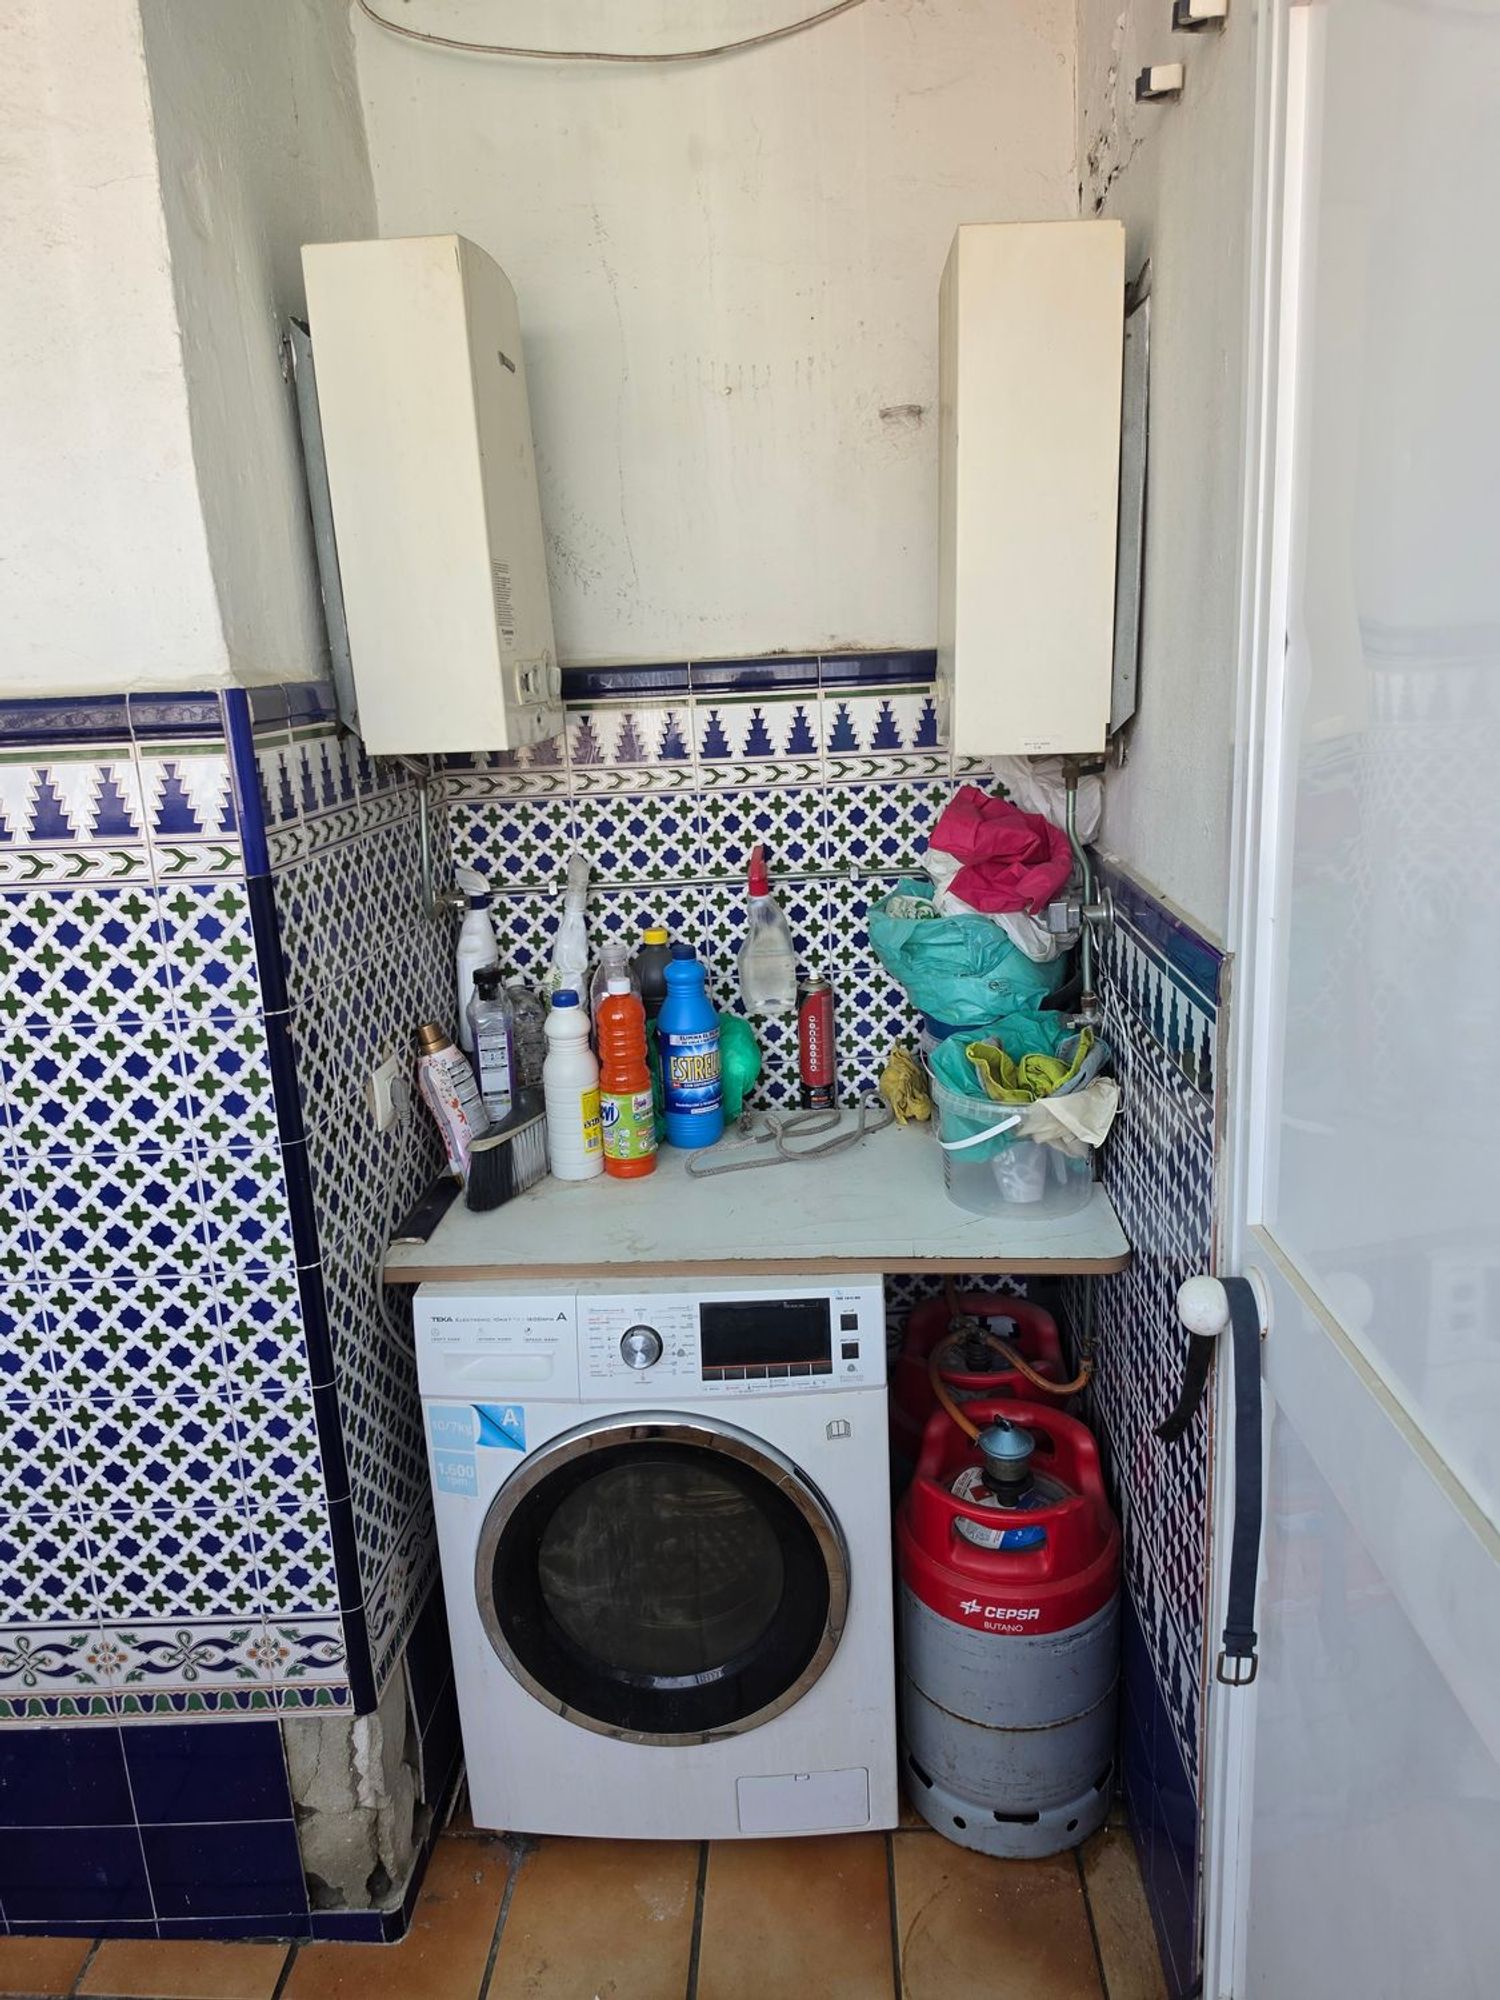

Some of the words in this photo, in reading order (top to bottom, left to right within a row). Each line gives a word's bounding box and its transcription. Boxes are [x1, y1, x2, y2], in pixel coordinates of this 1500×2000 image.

[556, 1312, 568, 1322] A
[502, 1409, 519, 1426] A
[437, 1462, 475, 1477] 1.600
[984, 1606, 1041, 1621] CEPSA
[983, 1621, 1024, 1633] BUTANO
